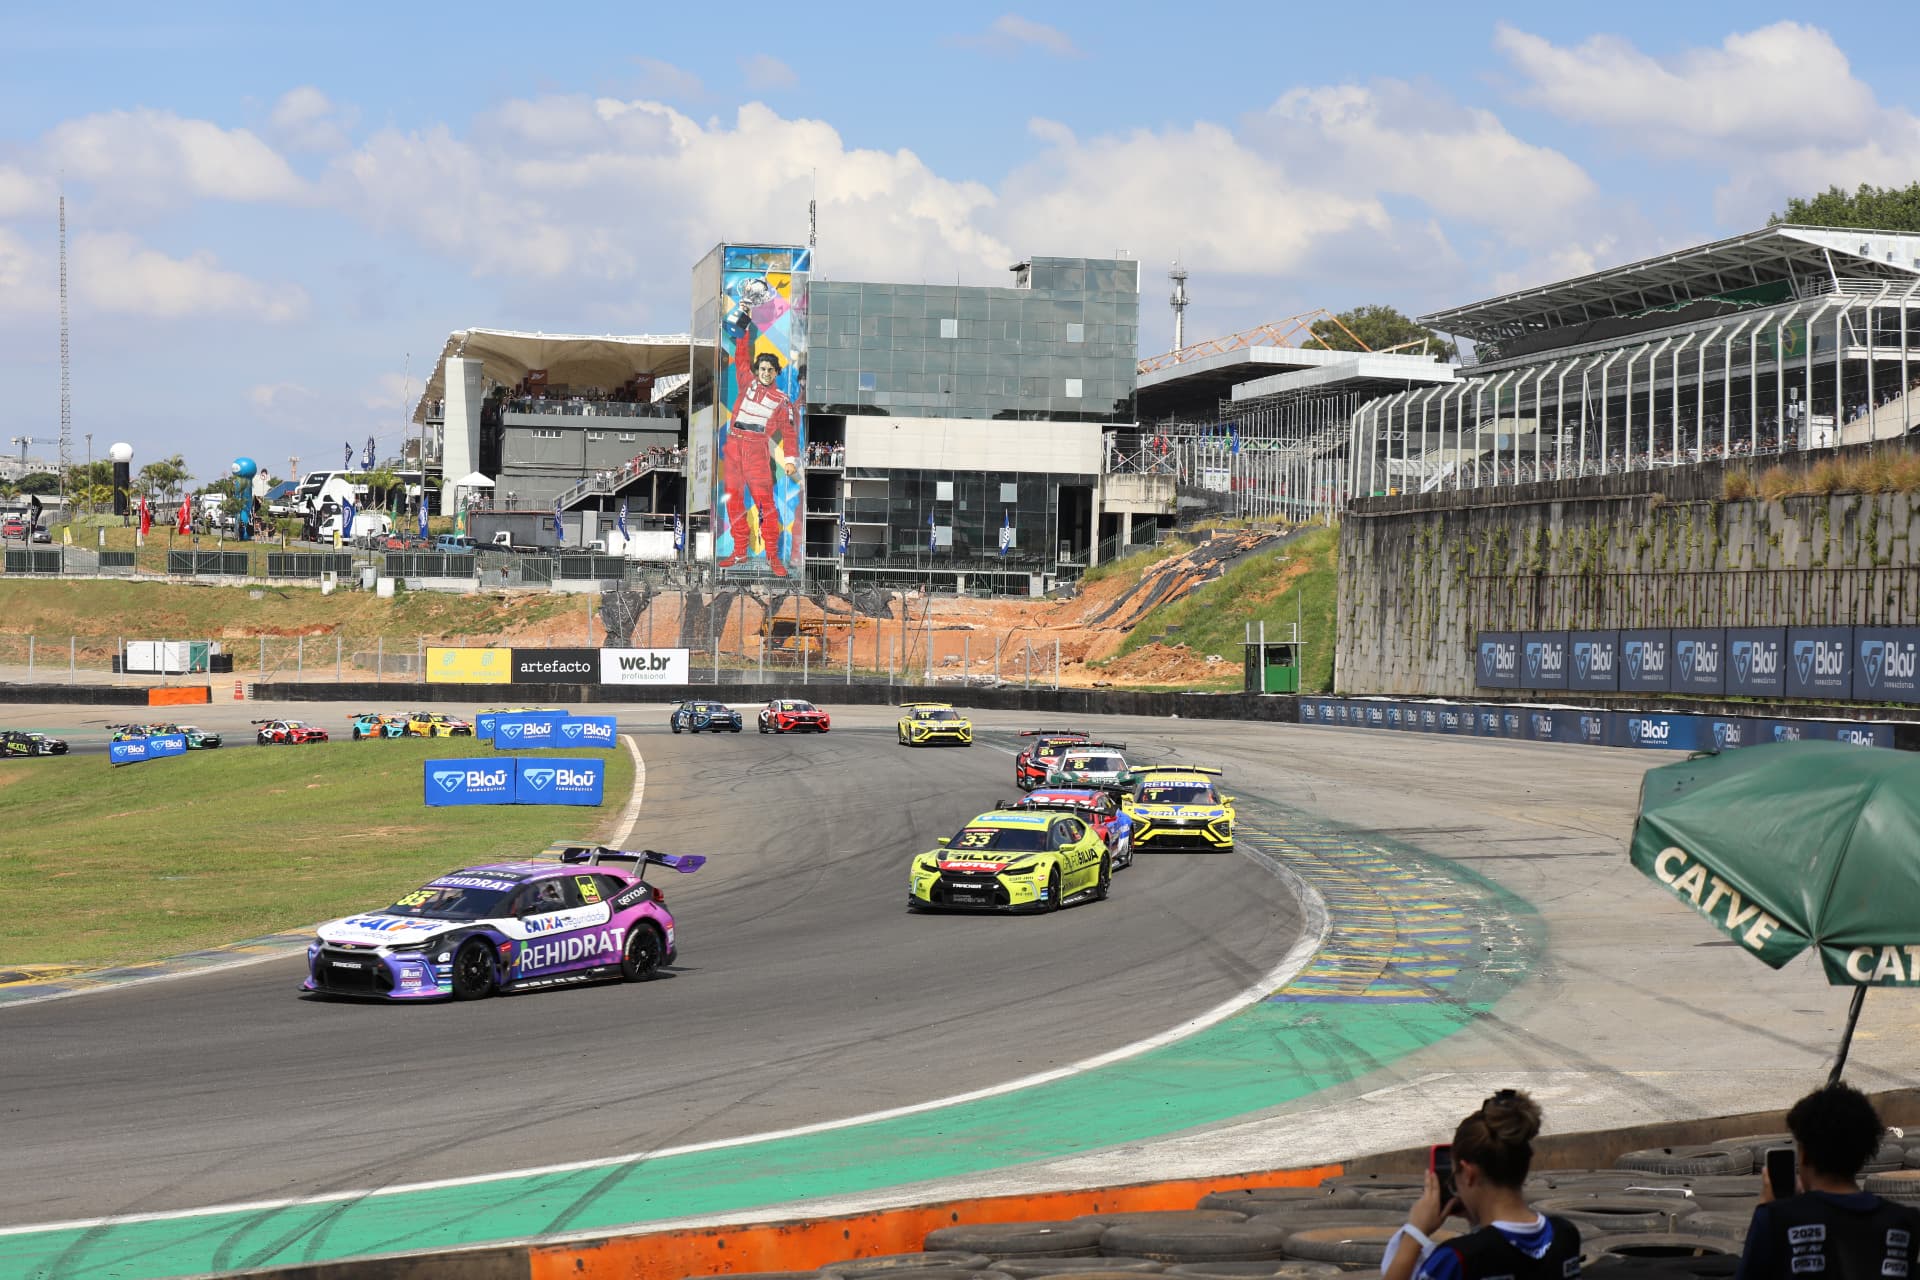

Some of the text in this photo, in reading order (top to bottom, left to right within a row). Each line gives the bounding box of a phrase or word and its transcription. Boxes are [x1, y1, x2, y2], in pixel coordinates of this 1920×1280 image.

[520, 660, 591, 673] artefacto
[620, 652, 671, 671] we.br
[621, 672, 667, 681] profissional
[961, 835, 991, 846] 33
[947, 861, 998, 869] MOTUL
[431, 876, 516, 891] REHIDRAT
[580, 884, 596, 896] 85
[396, 893, 433, 906] 85
[1654, 847, 1780, 951] CATVE
[524, 915, 564, 934] CAIXA
[521, 927, 626, 973] REHIDRAT
